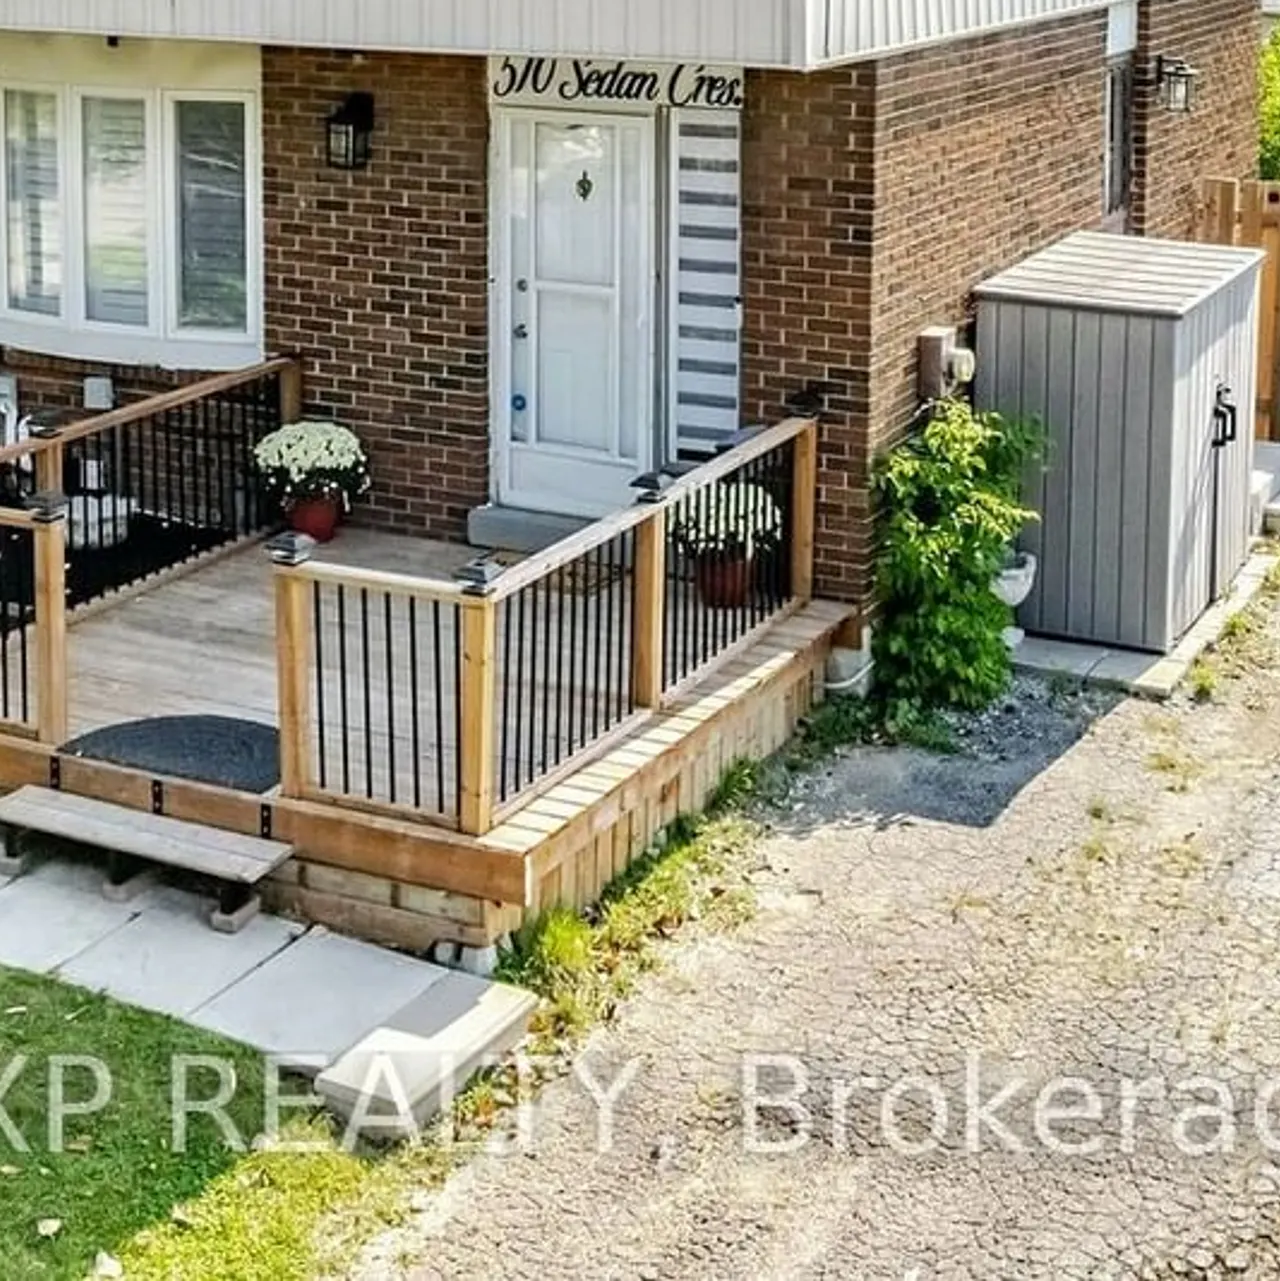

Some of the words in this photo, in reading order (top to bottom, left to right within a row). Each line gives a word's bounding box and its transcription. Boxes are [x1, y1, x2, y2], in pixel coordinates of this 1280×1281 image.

[493, 55, 557, 97] 510
[558, 58, 661, 101] Sedan
[667, 63, 743, 108] Cres.
